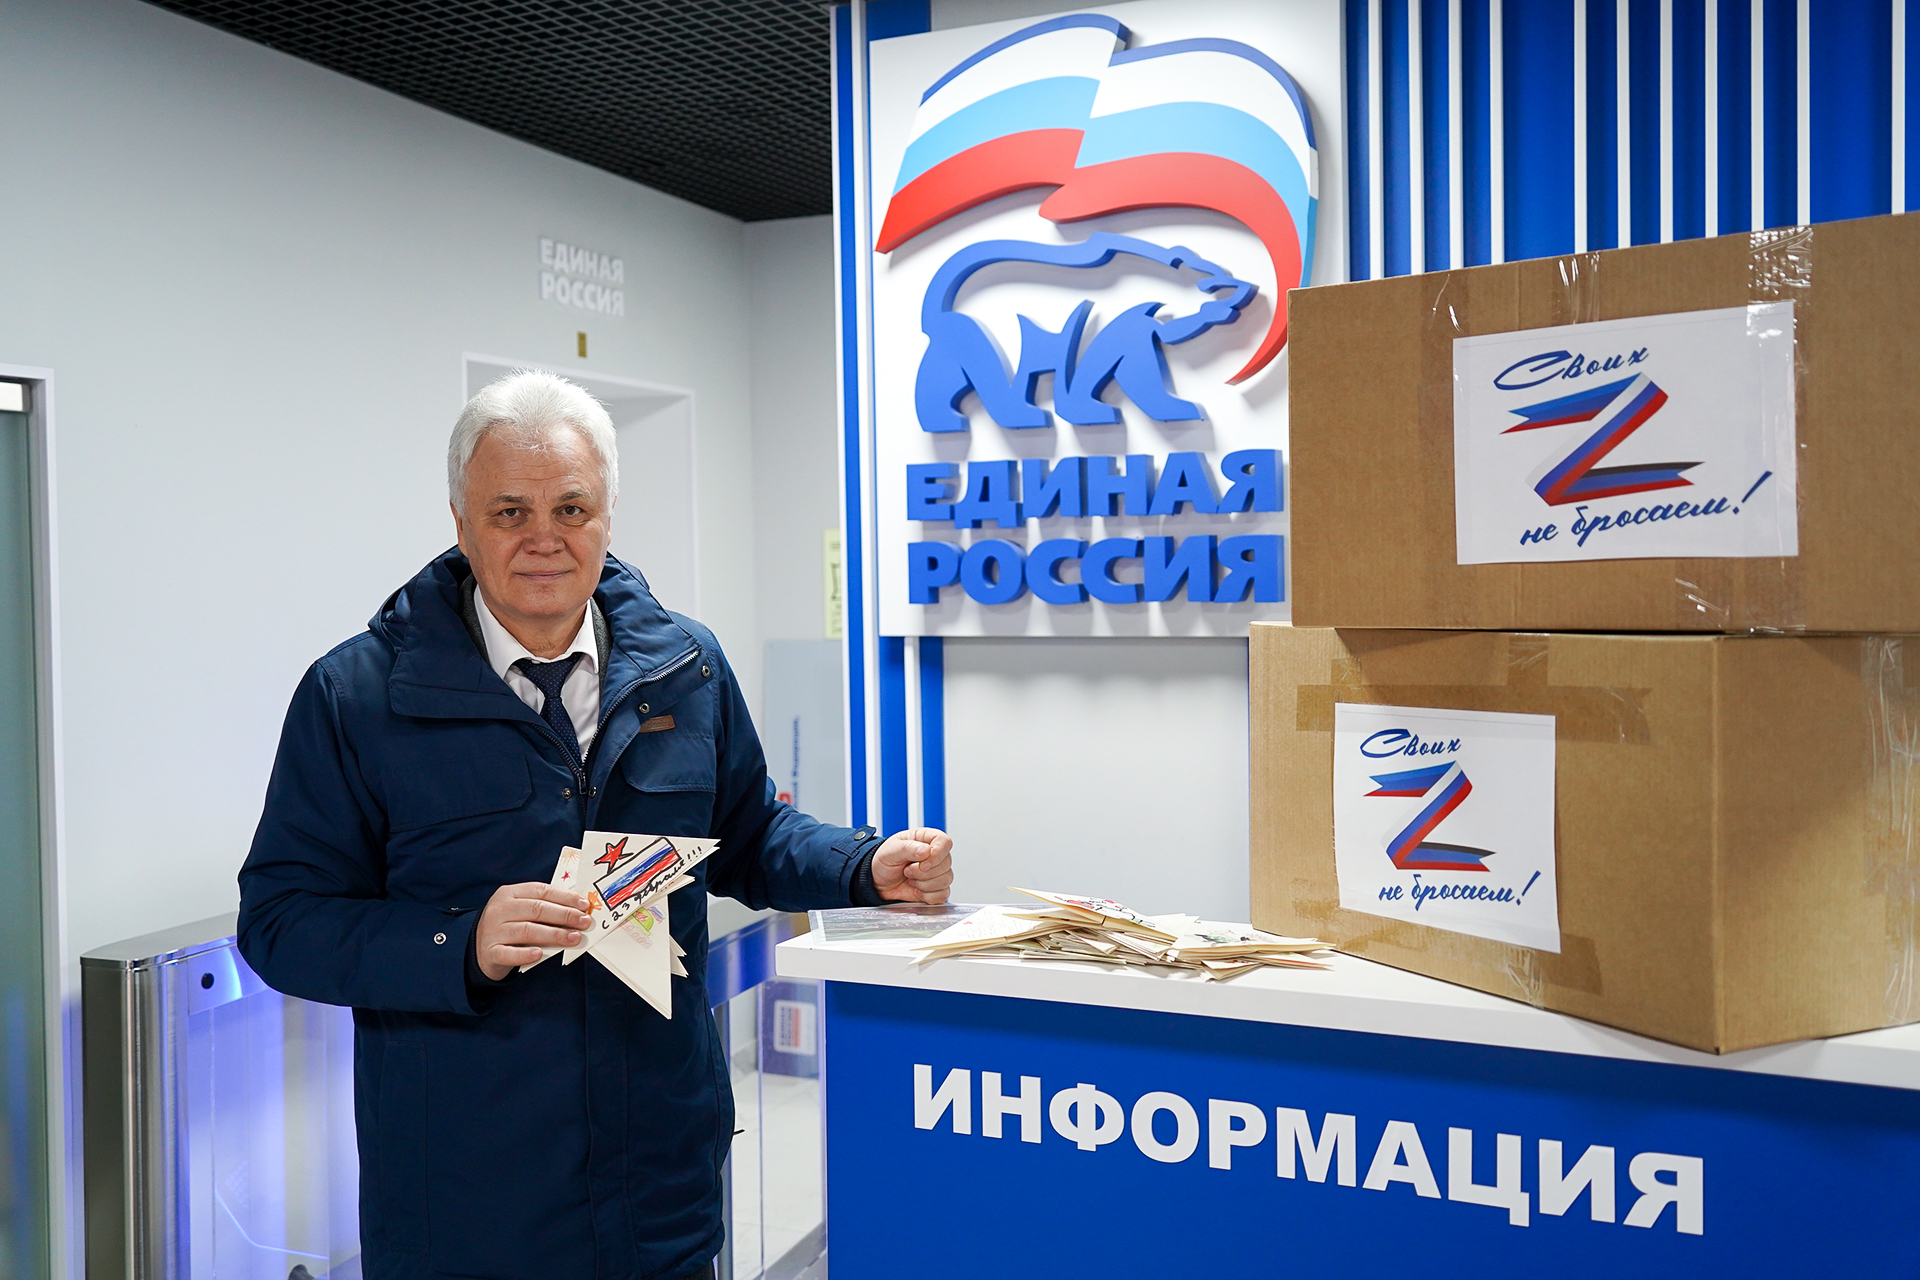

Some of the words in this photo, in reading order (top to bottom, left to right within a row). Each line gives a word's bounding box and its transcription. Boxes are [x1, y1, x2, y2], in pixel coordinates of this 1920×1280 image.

[540, 237, 624, 284] ЕДИНАЯ
[540, 270, 624, 317] РОССИЯ
[1493, 346, 1650, 391] Своих
[906, 448, 1284, 529] ЕДИНАЯ
[1519, 523, 1559, 546] не
[1571, 469, 1773, 548] бросаем!
[907, 534, 1286, 606] РОССИЯ
[1359, 728, 1462, 759] Своих
[1378, 883, 1404, 901] не
[1411, 869, 1542, 912] бросаем!
[913, 1063, 1705, 1236] ИНФОРМАЦИЯ
